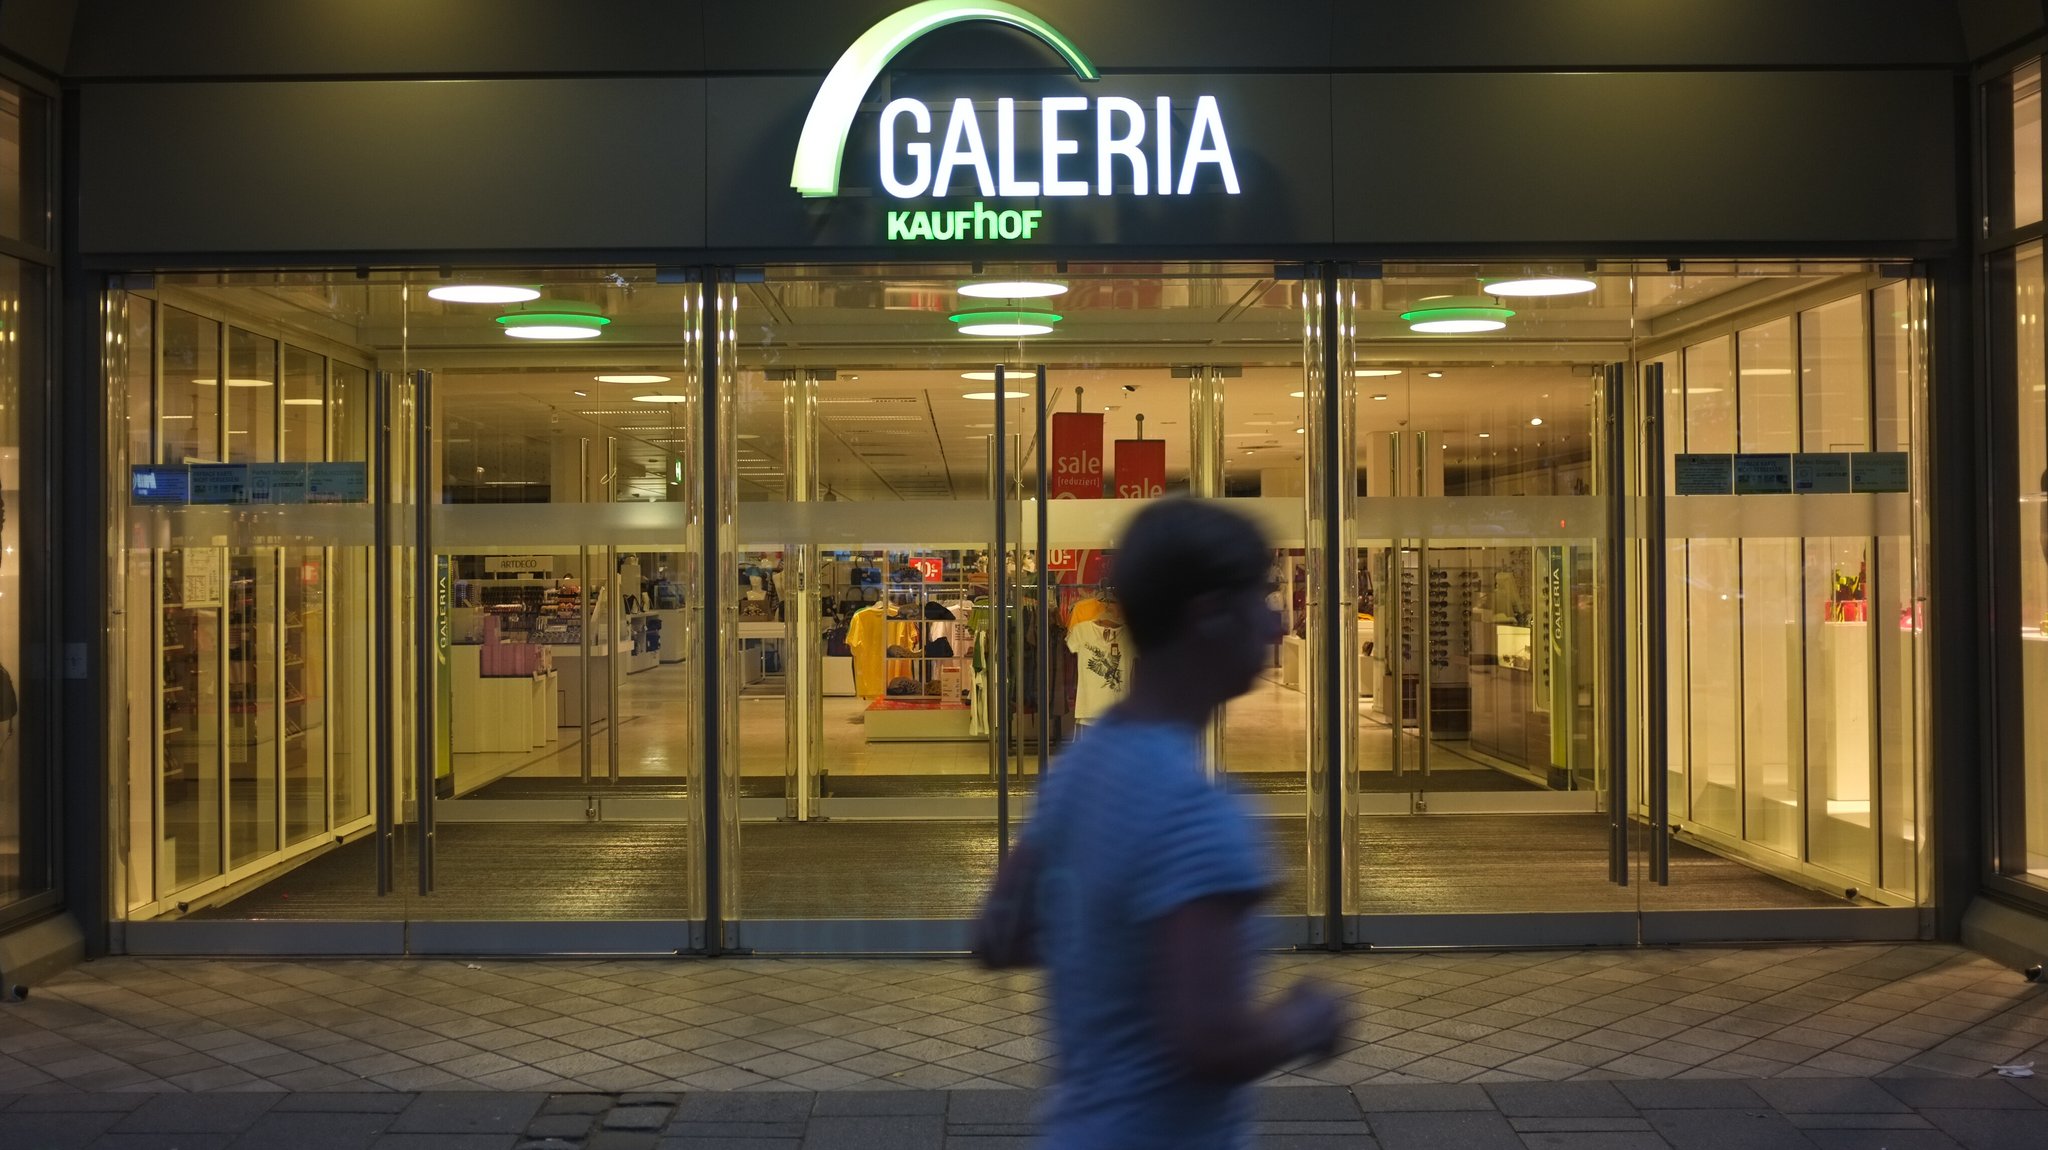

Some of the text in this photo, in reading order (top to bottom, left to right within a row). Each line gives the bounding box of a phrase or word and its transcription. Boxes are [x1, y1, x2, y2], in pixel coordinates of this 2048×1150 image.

[879, 95, 1241, 199] GALERIA
[1058, 450, 1100, 474] sale
[1119, 477, 1163, 499] sale
[500, 559, 537, 568] ARTDECO
[439, 576, 448, 649] GALERIA
[1553, 568, 1562, 640] GALERIA
